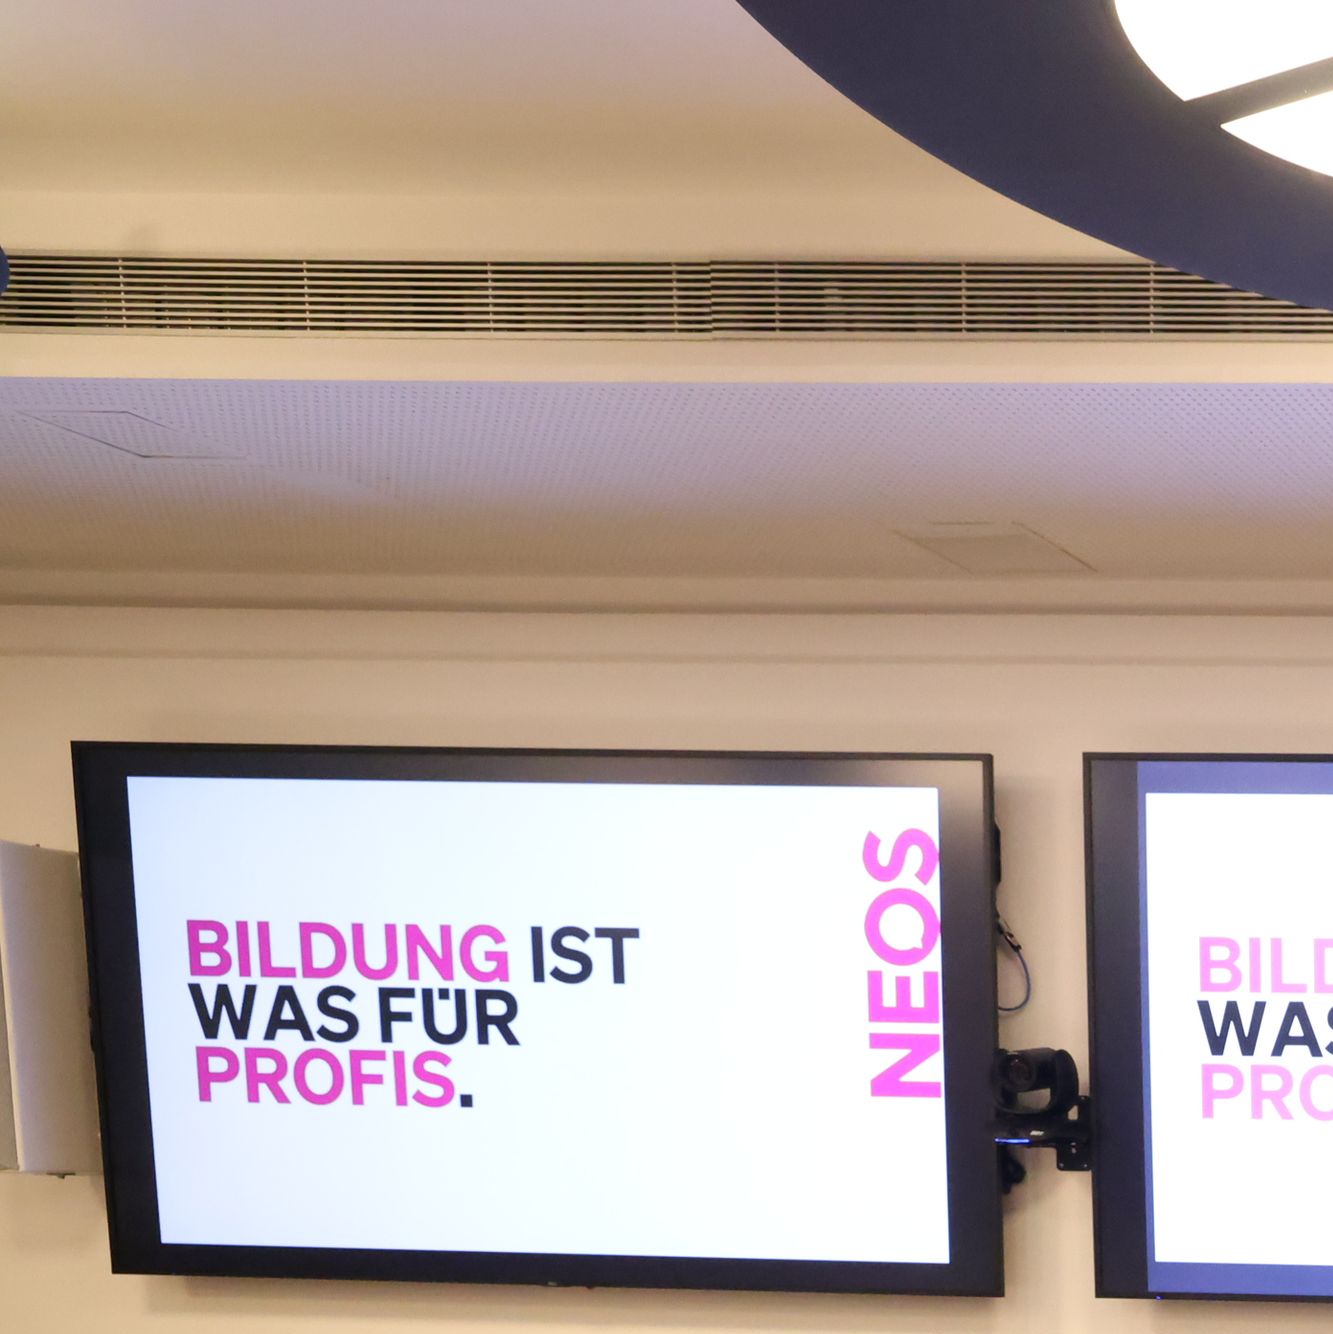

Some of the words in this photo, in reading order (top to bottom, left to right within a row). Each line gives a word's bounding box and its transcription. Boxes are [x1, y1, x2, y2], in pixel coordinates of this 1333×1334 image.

[186, 919, 509, 983] BILDUNG
[530, 925, 640, 985] IST
[862, 828, 942, 1099] NEOS
[187, 983, 360, 1044] WAS
[378, 985, 521, 1046] FÜR
[195, 1046, 473, 1108] PROFIS.
